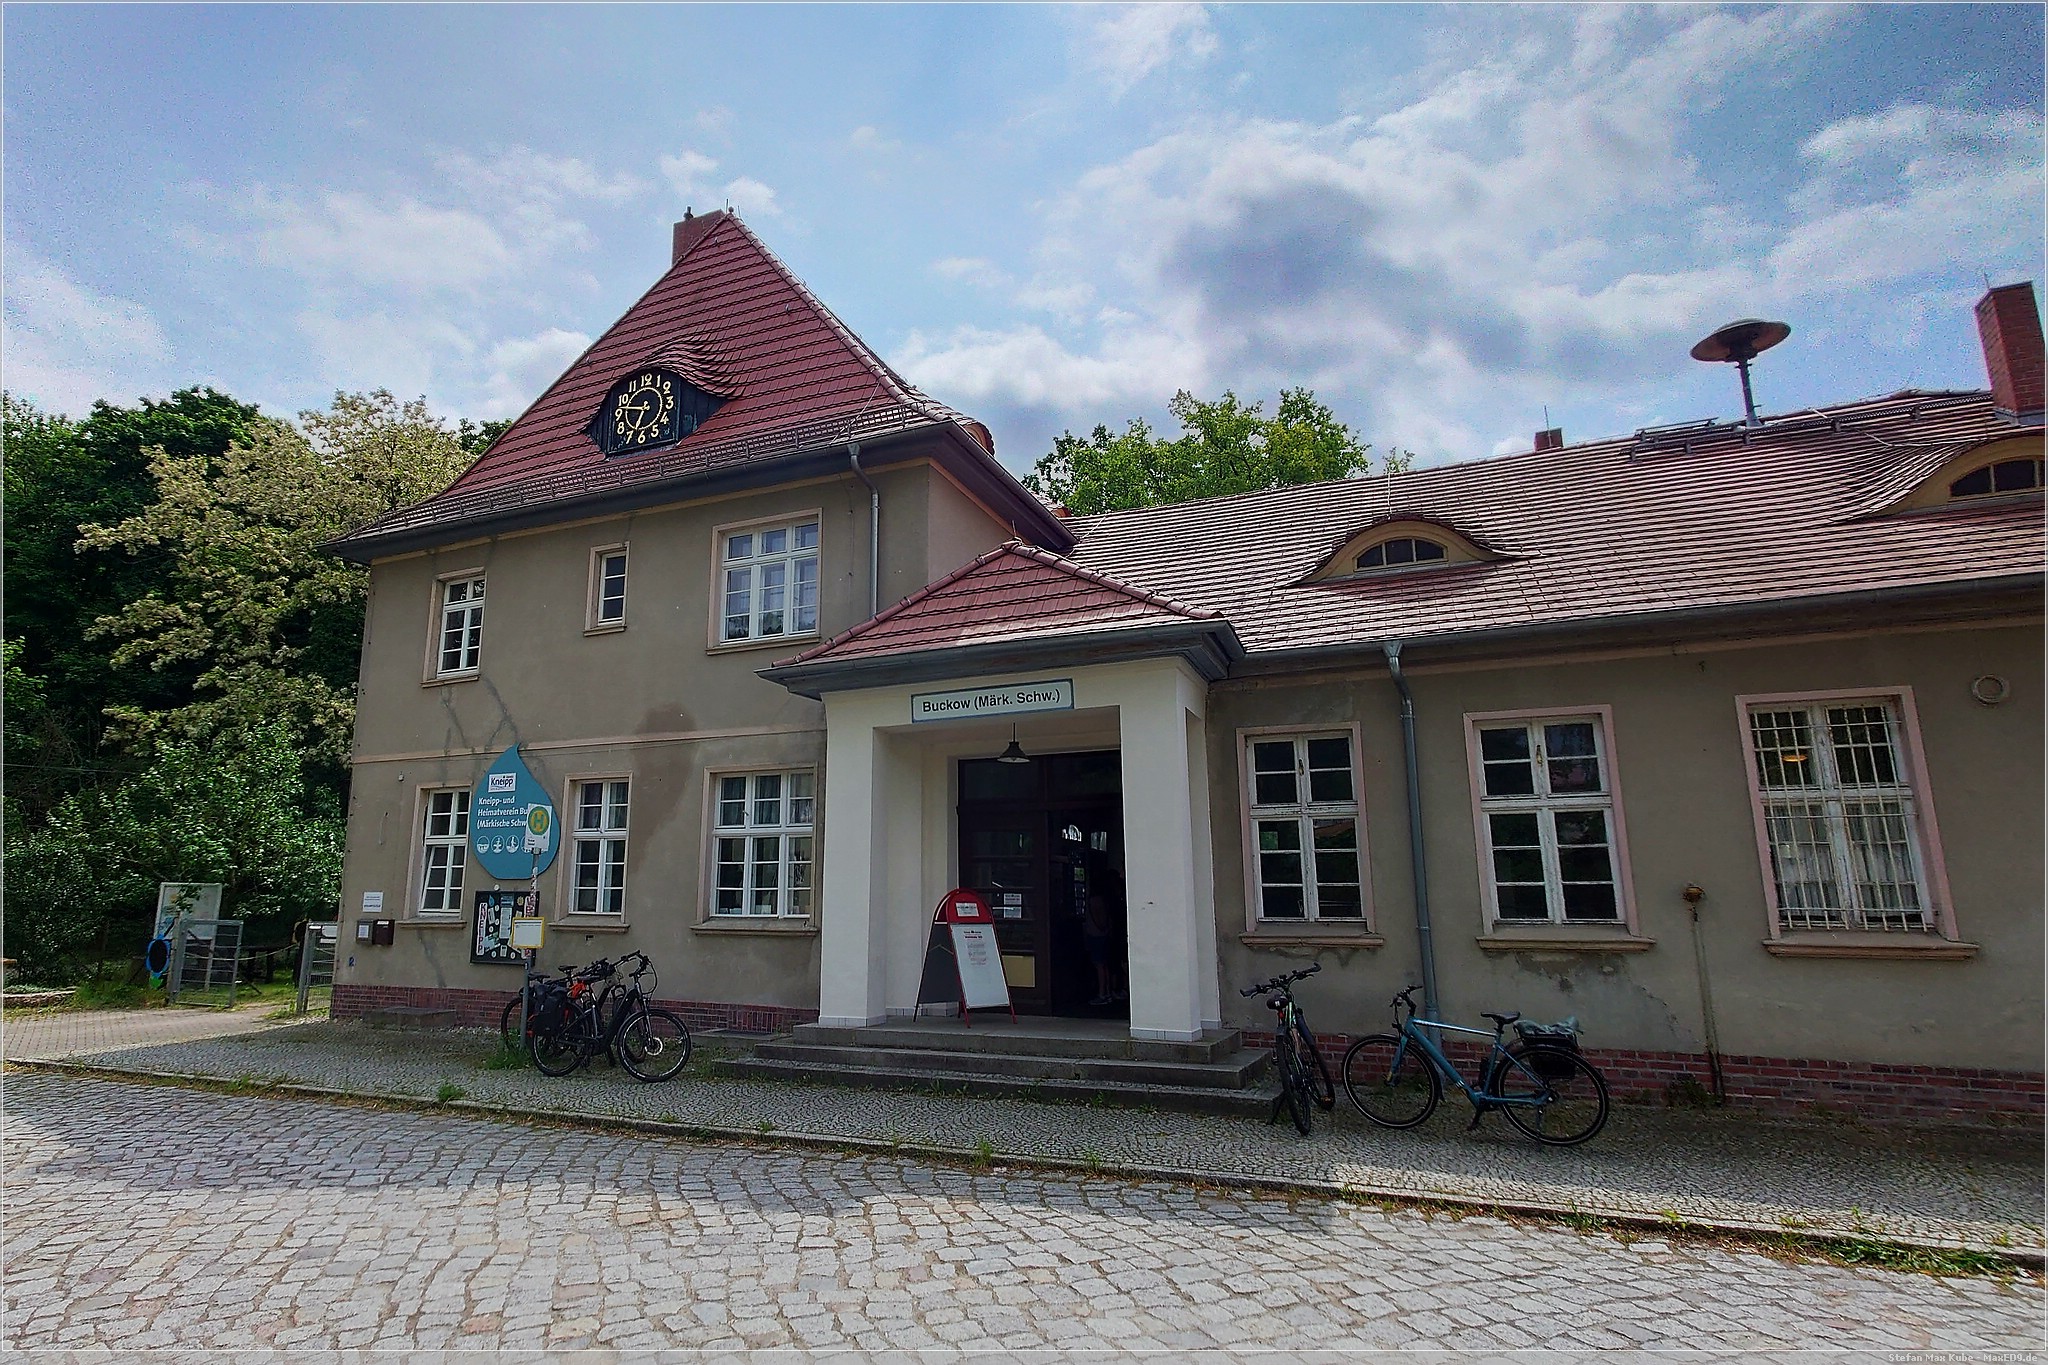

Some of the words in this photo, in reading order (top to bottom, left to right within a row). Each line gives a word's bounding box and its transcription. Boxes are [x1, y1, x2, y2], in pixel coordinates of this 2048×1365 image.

[641, 373, 653, 387] 12
[657, 375, 661, 387] 1
[628, 380, 637, 393] 11
[663, 381, 671, 394] 2
[619, 394, 628, 406] 10
[666, 396, 674, 409] 3
[615, 409, 623, 421] 9
[660, 411, 669, 425] 4
[617, 422, 624, 434] 8
[651, 425, 659, 437] 5
[626, 431, 633, 444] 7
[638, 431, 645, 443] 6
[922, 698, 971, 713] Buckow
[974, 693, 1013, 711] (Märk.
[1016, 688, 1061, 705] Schw.)
[490, 775, 514, 787] Kneipp
[478, 796, 502, 806] Kneipp-
[502, 795, 515, 804] und
[477, 807, 519, 817] Heimatverein
[477, 818, 510, 829] (Märkische
